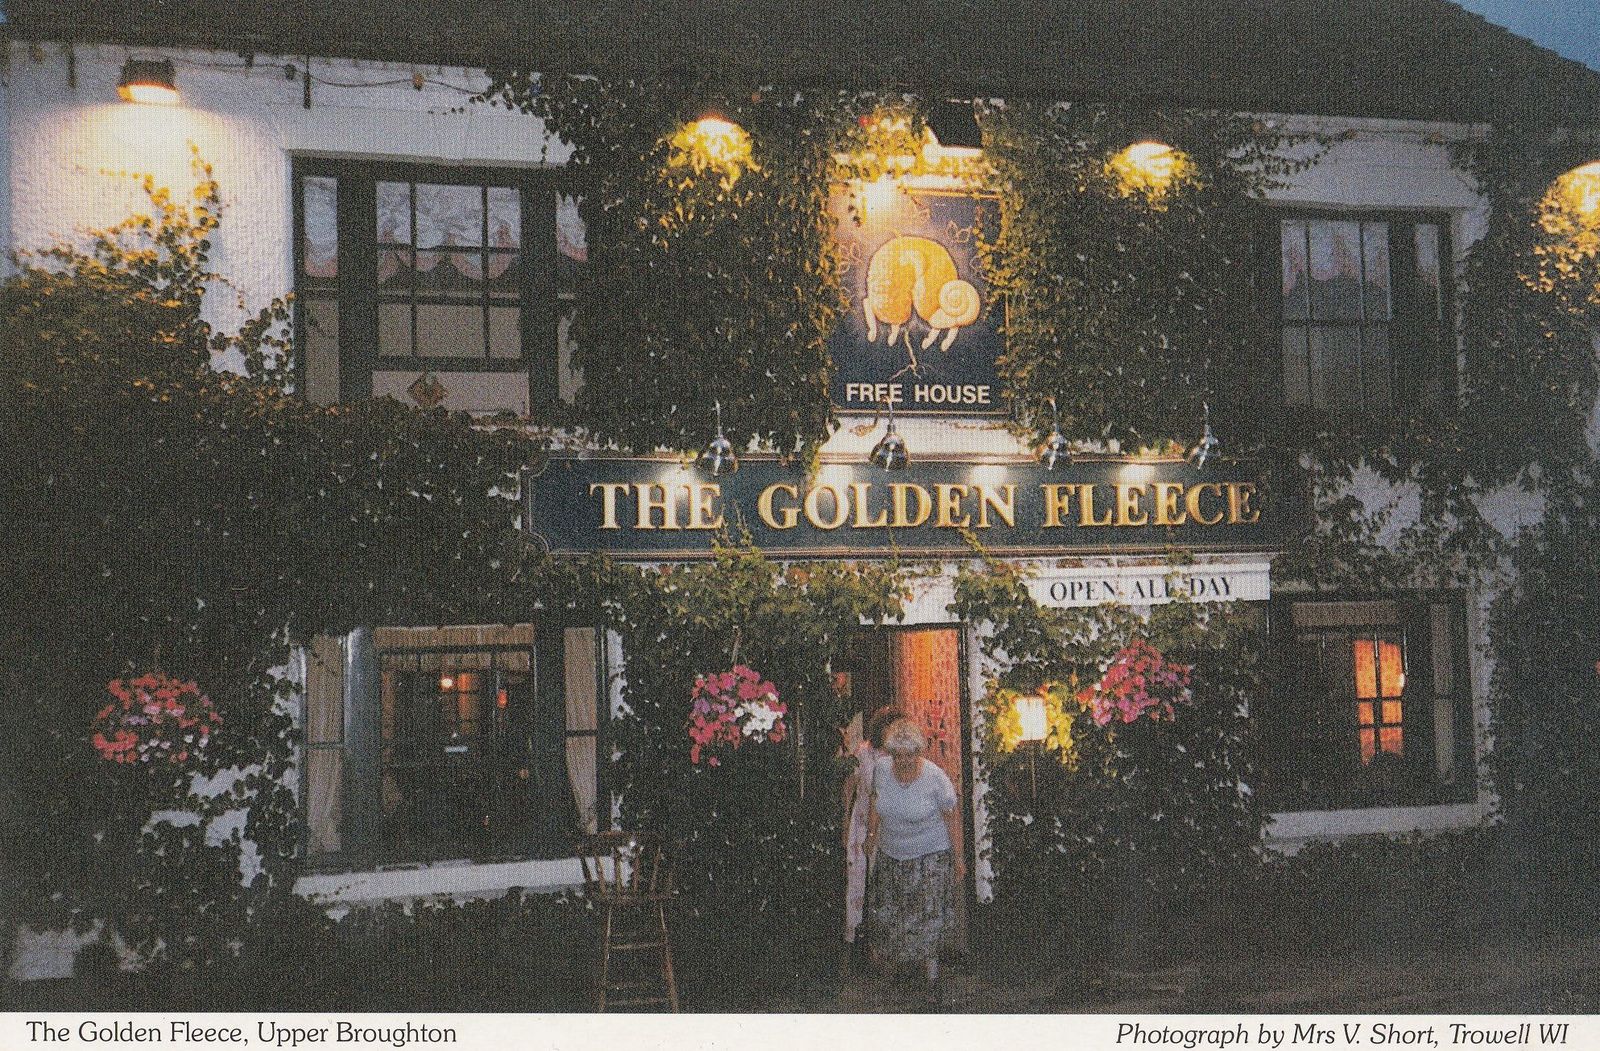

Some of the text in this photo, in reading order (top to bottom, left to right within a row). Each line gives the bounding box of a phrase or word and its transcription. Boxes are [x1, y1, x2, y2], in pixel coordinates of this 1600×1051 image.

[846, 383, 991, 404] FREE HOUSE
[590, 482, 1261, 530] THE GOLDEN FLEECE
[1049, 580, 1118, 601] OPEN
[1190, 575, 1233, 598] DAY
